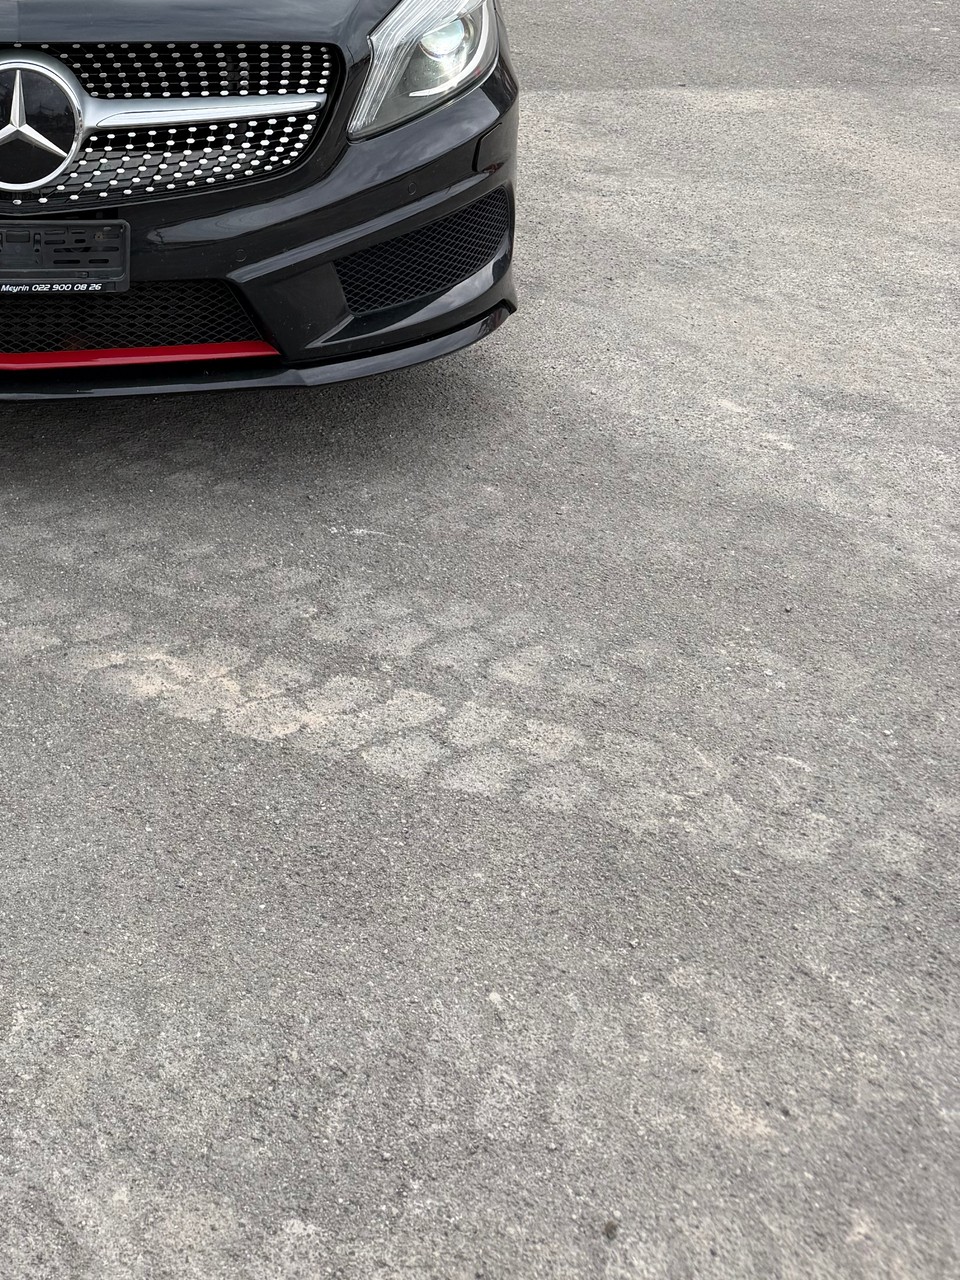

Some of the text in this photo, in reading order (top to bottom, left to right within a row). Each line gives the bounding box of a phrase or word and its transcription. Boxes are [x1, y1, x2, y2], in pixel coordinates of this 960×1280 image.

[0, 284, 30, 293] Meyrin
[31, 284, 51, 292] 022
[52, 283, 72, 291] 900
[73, 283, 88, 291] 08
[88, 283, 102, 291] 26
